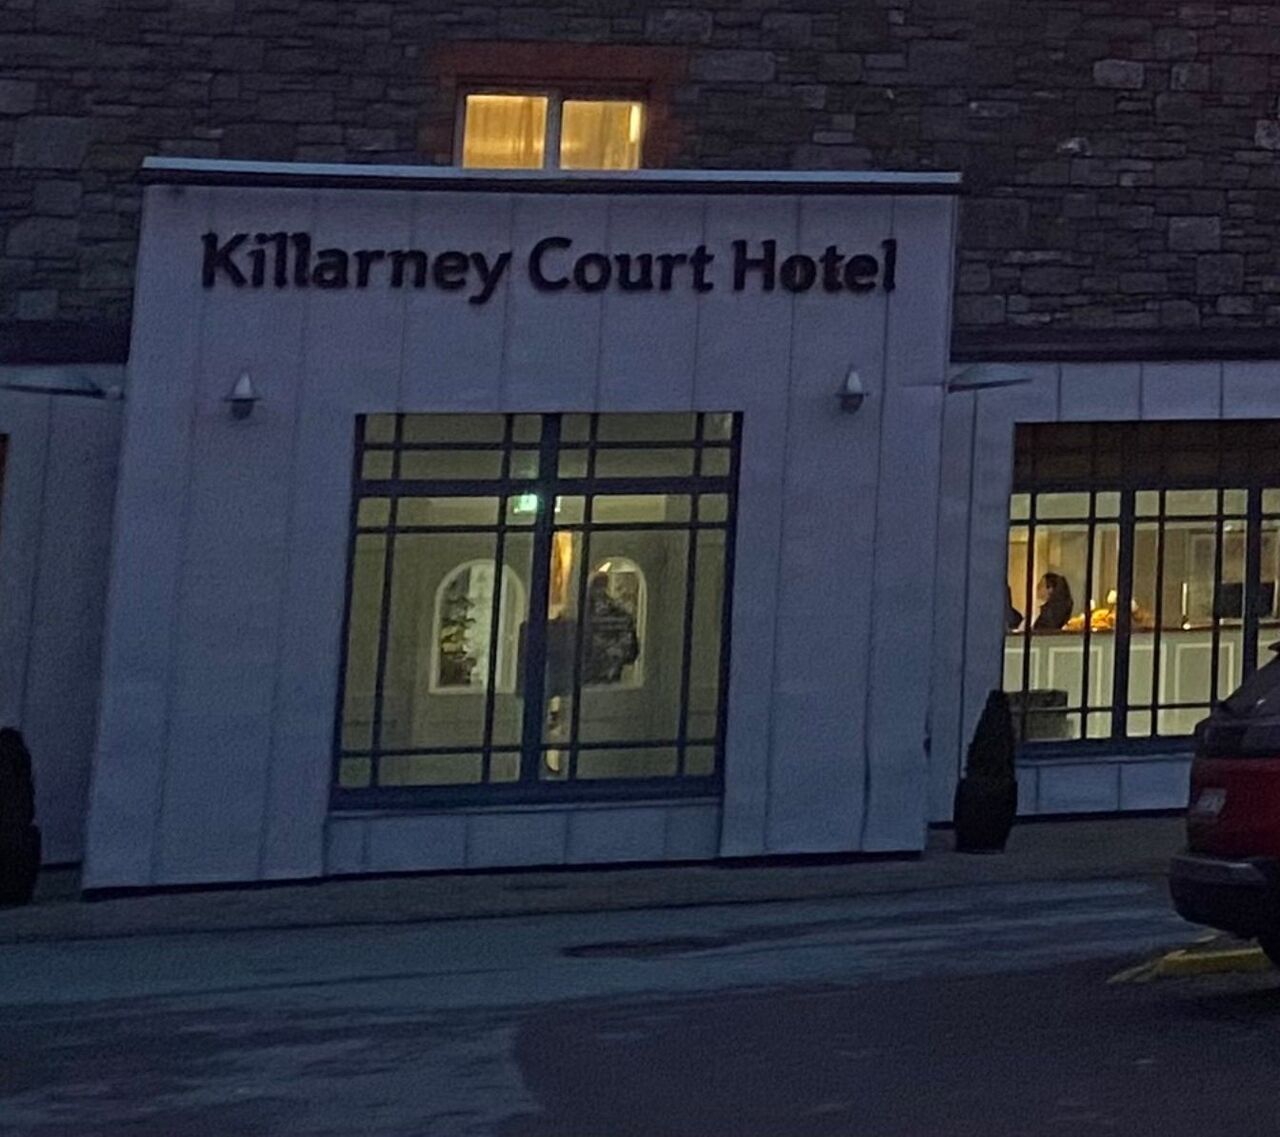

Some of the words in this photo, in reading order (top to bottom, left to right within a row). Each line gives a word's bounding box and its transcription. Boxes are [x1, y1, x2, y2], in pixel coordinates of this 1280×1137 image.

[201, 232, 513, 305] Killarney
[529, 237, 715, 293] Court
[731, 238, 897, 294] Hotel
